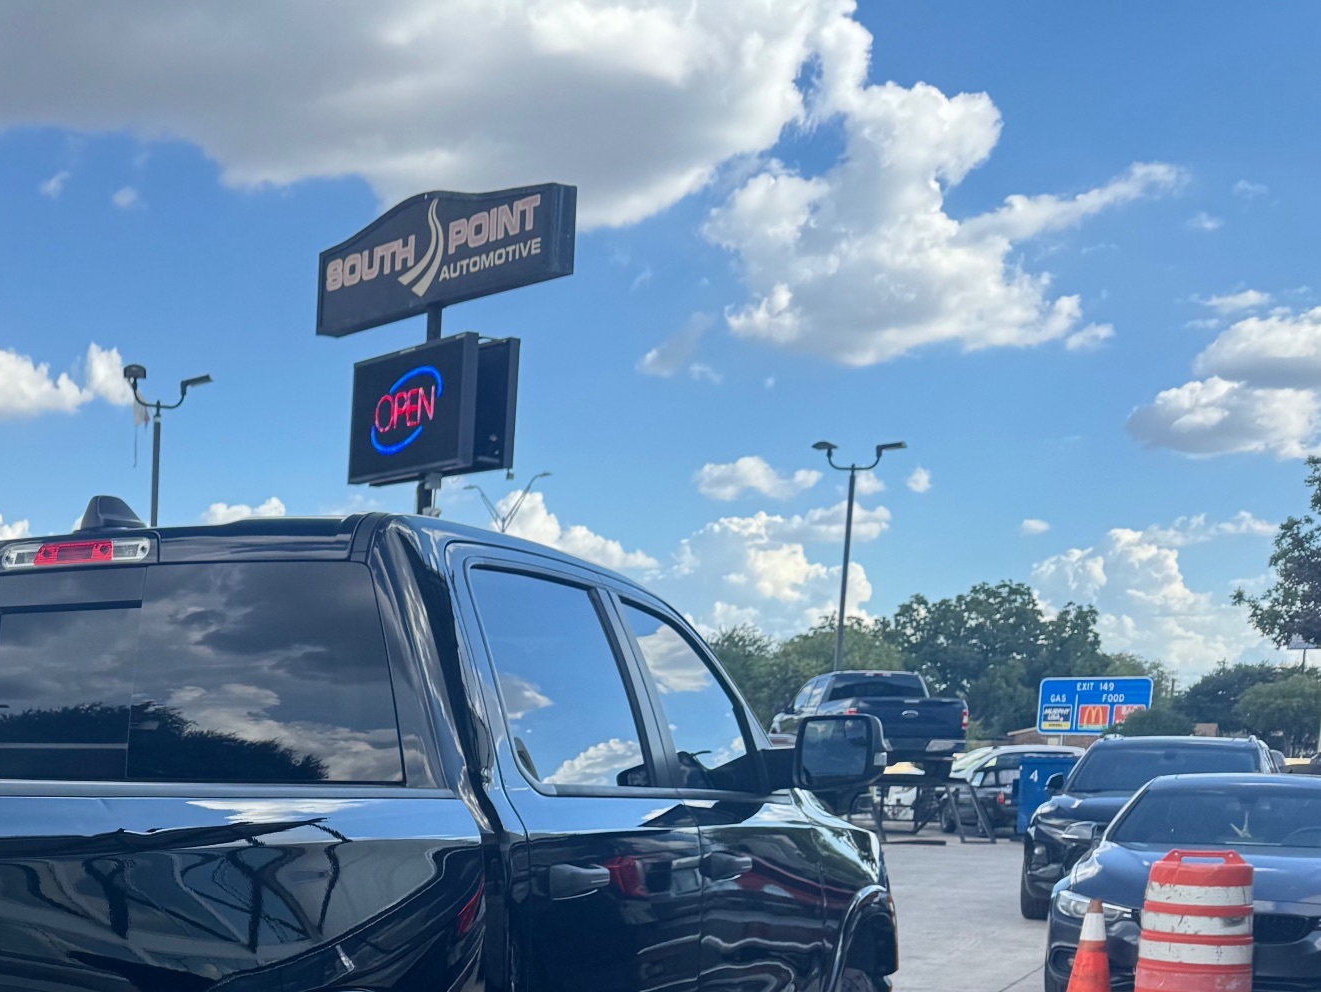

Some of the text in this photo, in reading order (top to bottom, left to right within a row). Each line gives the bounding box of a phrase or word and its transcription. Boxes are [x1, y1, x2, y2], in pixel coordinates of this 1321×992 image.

[325, 193, 541, 292] SOUTH POINT
[439, 238, 541, 282] AUTOMOTIVE
[375, 385, 436, 433] OPEN
[1076, 682, 1115, 692] EXIT 149
[1050, 693, 1067, 703] GAS
[1102, 693, 1125, 703] FOOD
[1029, 769, 1039, 783] 4
